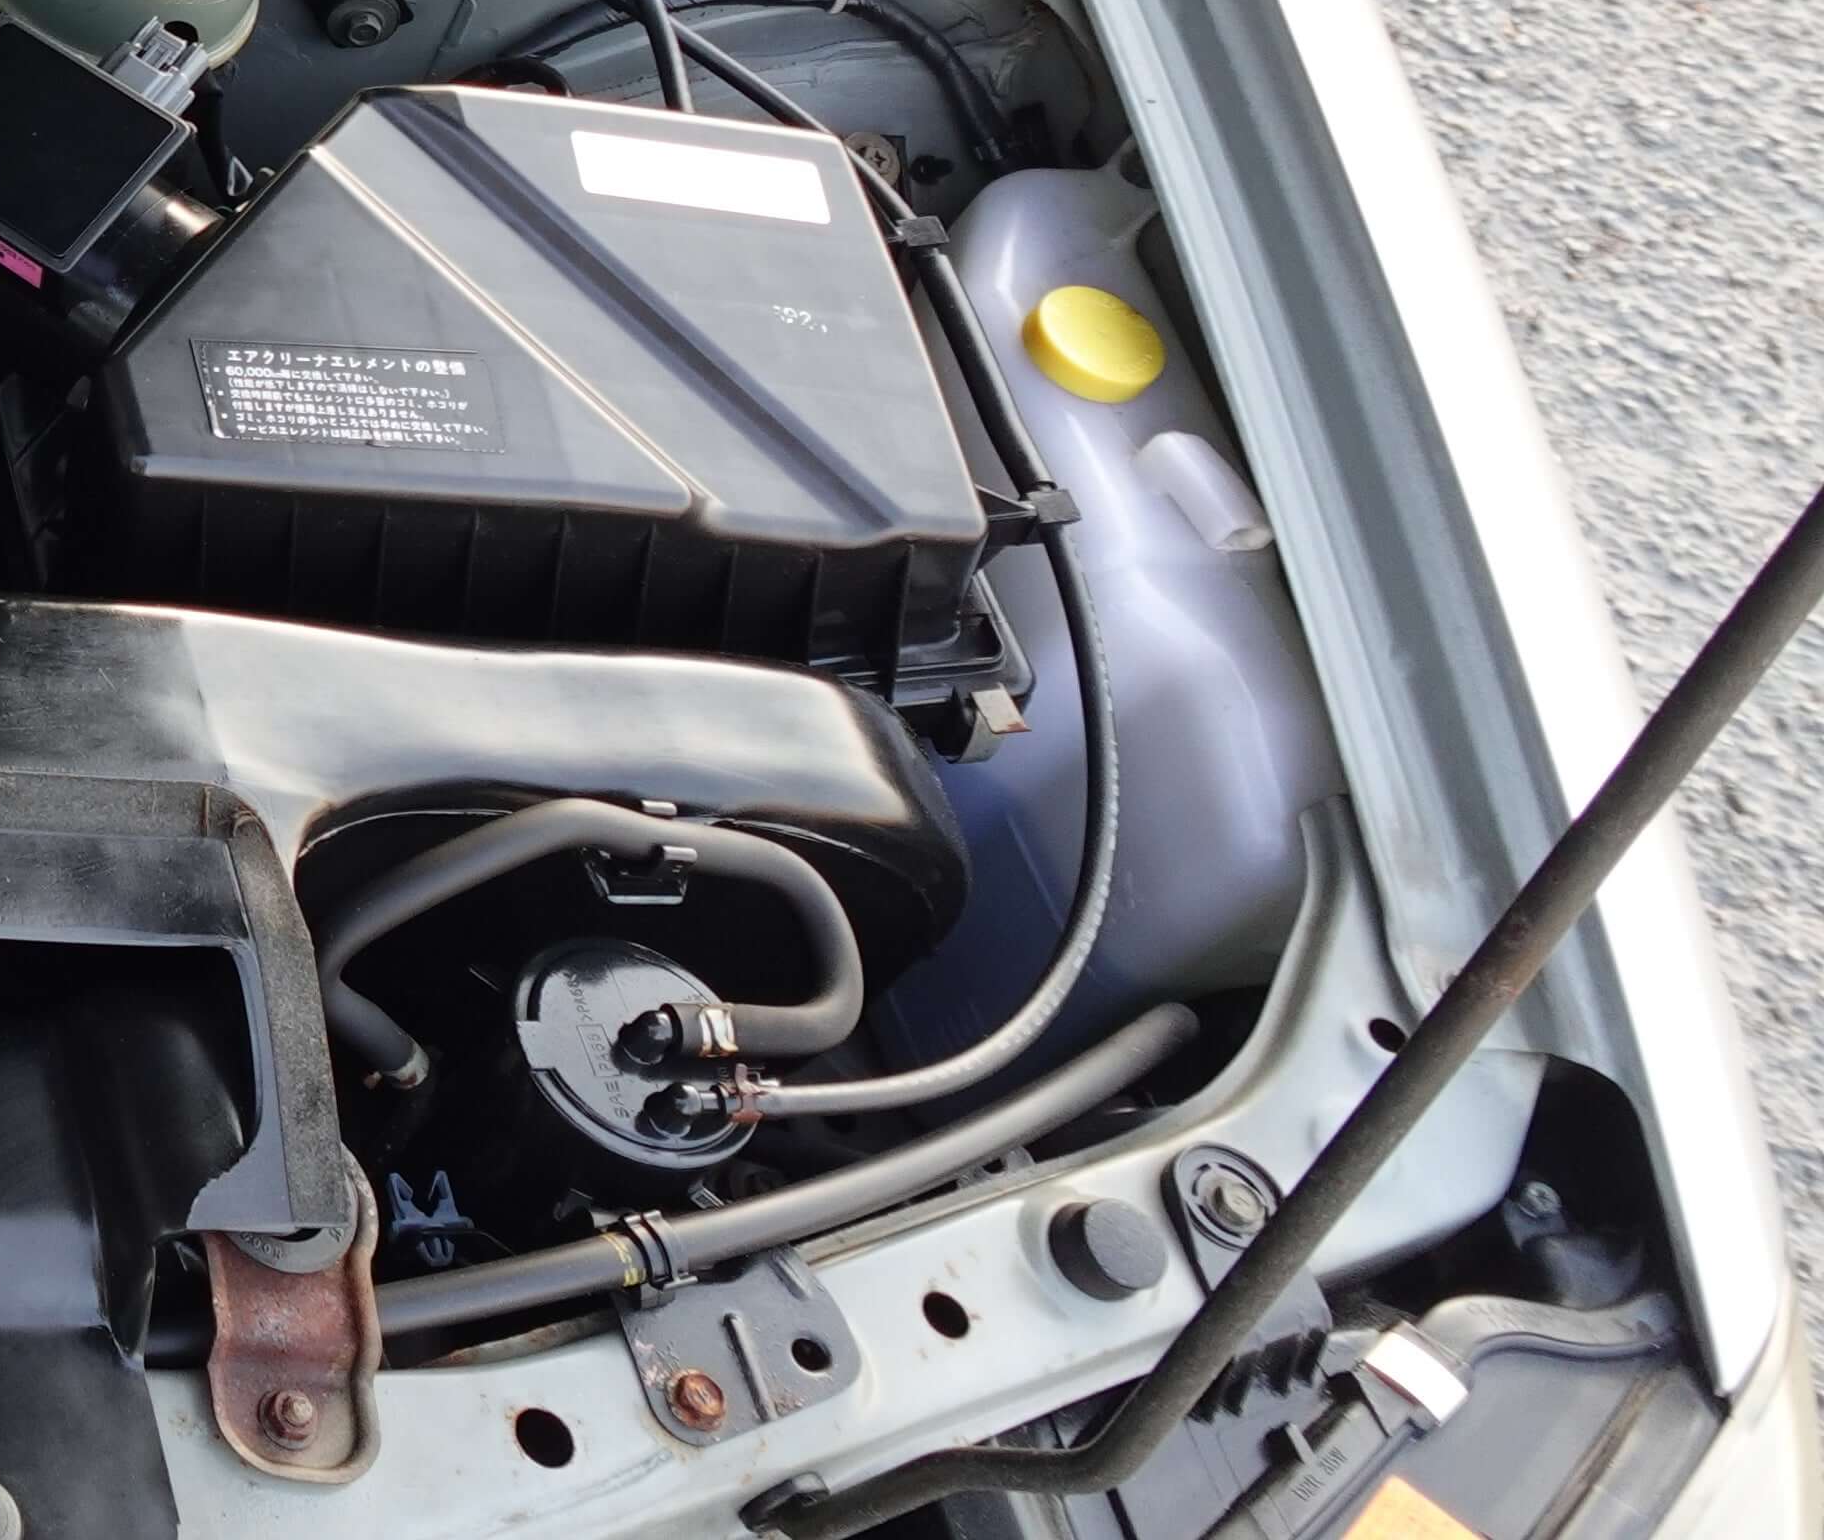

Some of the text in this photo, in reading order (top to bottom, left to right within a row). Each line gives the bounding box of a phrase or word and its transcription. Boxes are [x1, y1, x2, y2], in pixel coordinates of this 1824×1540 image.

[227, 350, 466, 376] エアクリーナエレメントの整備
